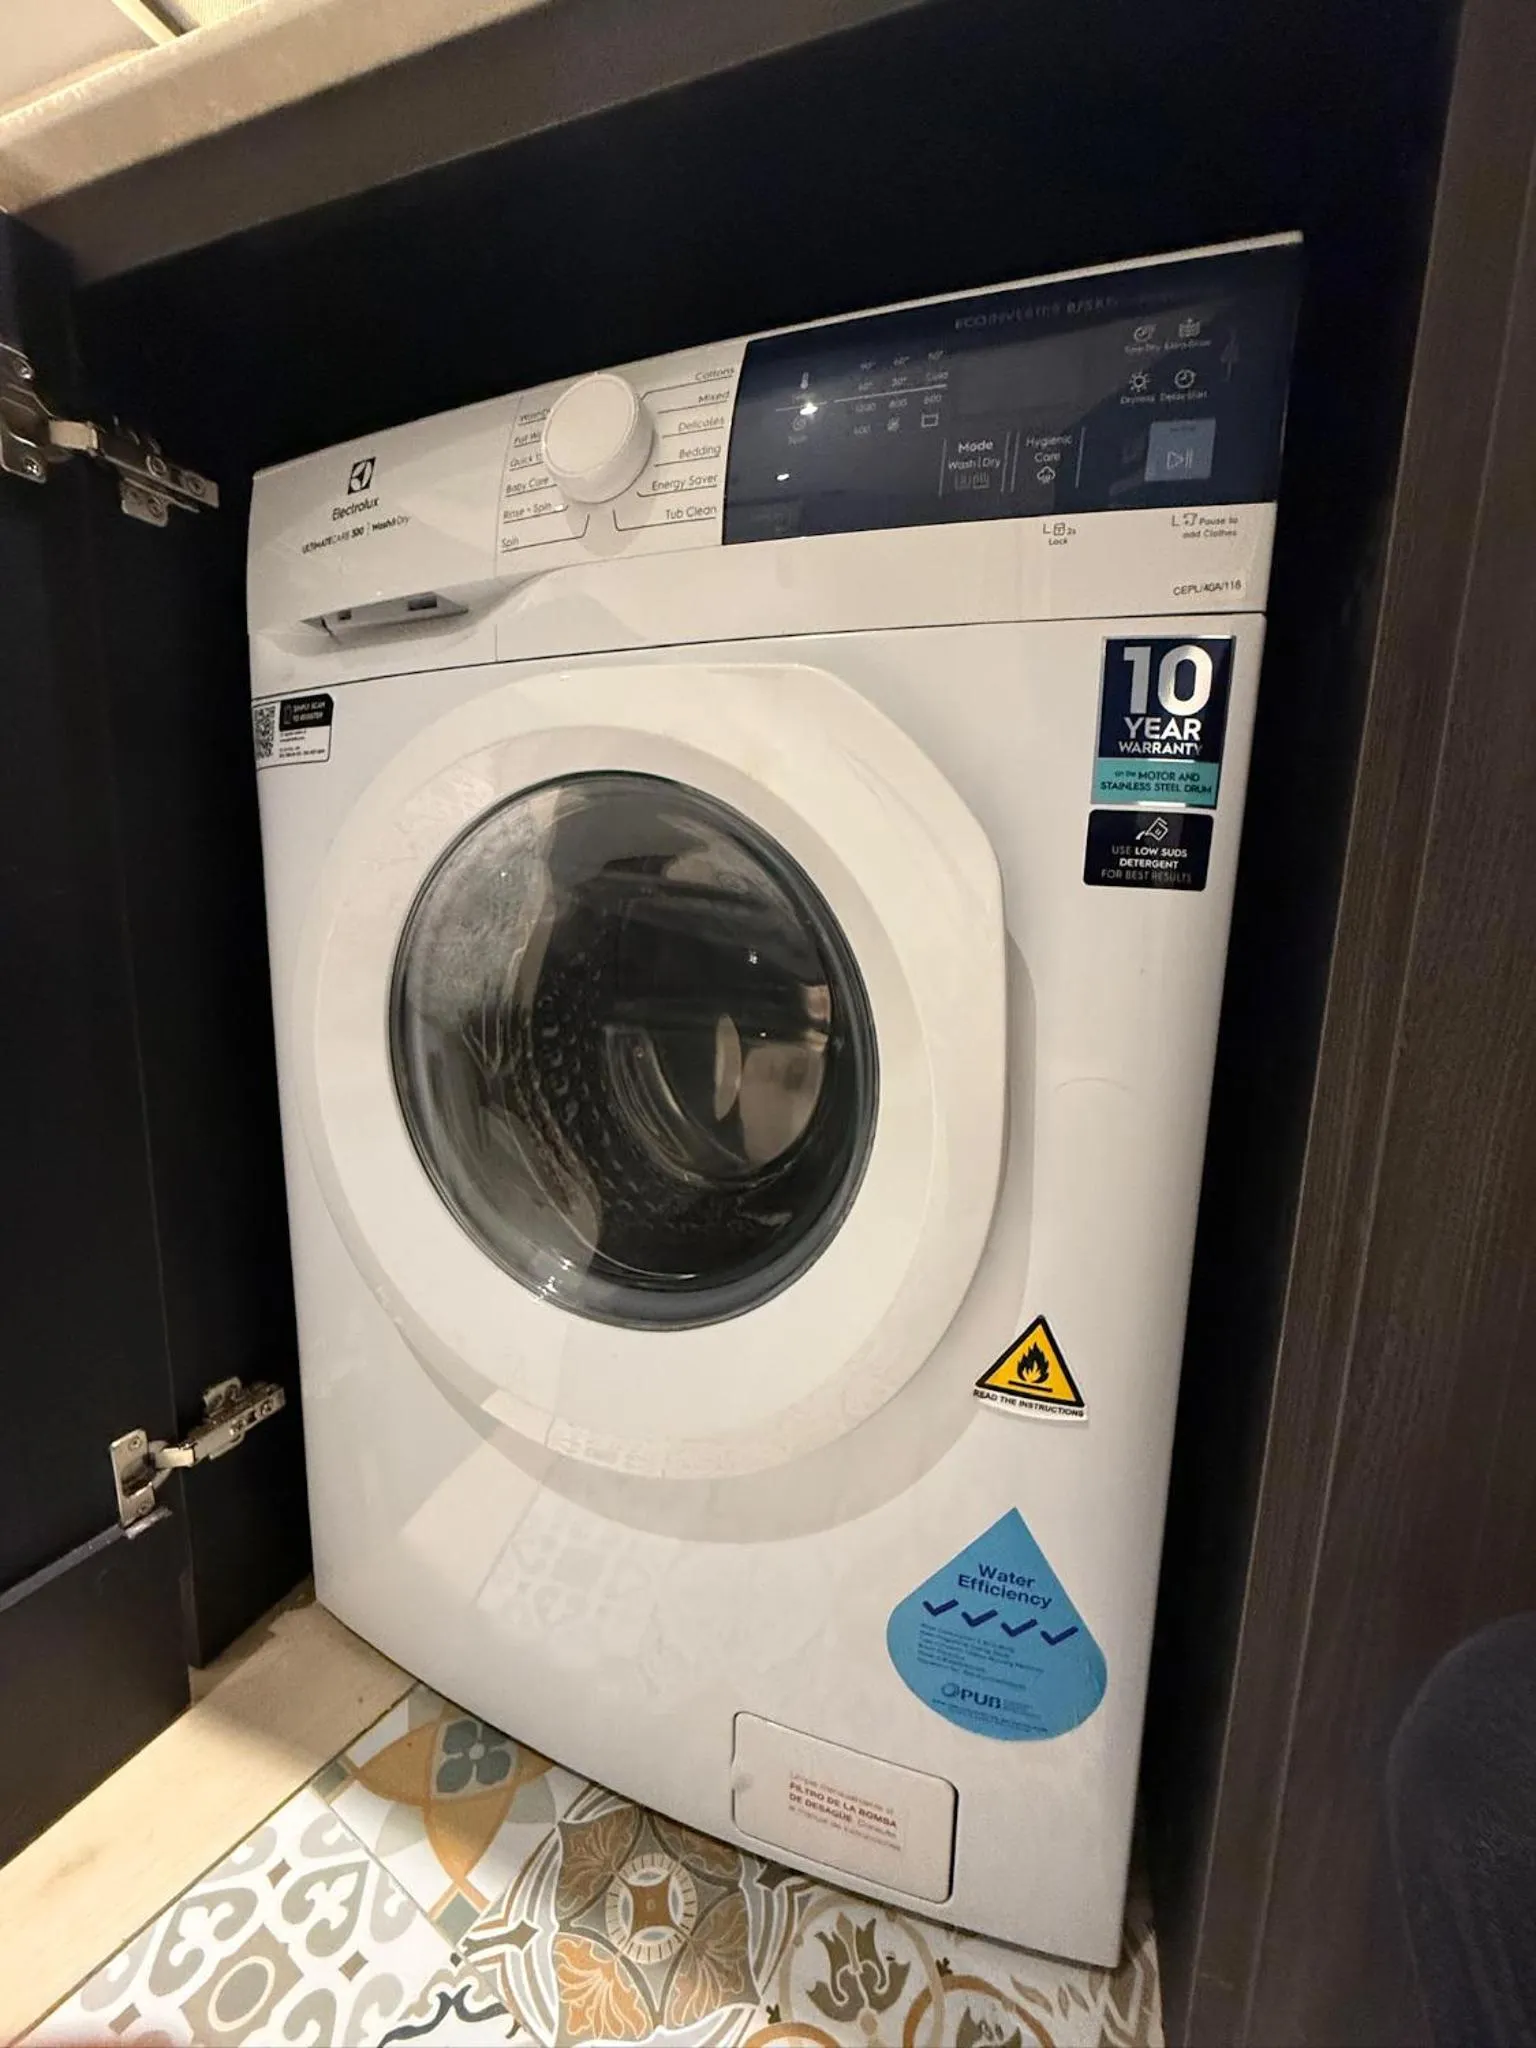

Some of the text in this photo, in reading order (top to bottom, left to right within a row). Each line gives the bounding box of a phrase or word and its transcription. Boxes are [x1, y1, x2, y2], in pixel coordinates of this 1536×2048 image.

[695, 367, 735, 381] Cottons
[698, 390, 731, 403] Mixed
[678, 416, 725, 433] Delicates
[958, 440, 994, 454] Mode
[1026, 434, 1073, 448] Hygienic
[679, 445, 722, 460] Bedding
[1034, 451, 1061, 463] Care
[948, 456, 1001, 471] Wash Dry
[652, 473, 718, 493] Energy Saver
[332, 497, 380, 521] Electrolux
[666, 505, 717, 520] Tub Clean
[1200, 514, 1225, 526] Pause
[1048, 537, 1068, 546] Lock
[1183, 529, 1238, 539] add Clothes
[1123, 644, 1213, 716] 10
[1124, 717, 1202, 741] YEAR
[1118, 741, 1203, 756] WARRANTY
[1138, 771, 1176, 782] MOTOR
[1178, 773, 1200, 783] AND
[1101, 781, 1212, 794] STAINLESS STEEL DRUM
[1111, 845, 1188, 858] USE LOW SUDS
[1119, 857, 1180, 870] DETERGENT
[1101, 868, 1192, 884] FOR BEST RESULTS
[972, 1388, 1085, 1418] READ THE INSTRUCTIONS
[978, 1563, 1036, 1588] Water
[957, 1574, 1053, 1609] Efficiency
[960, 1688, 1002, 1709] PUB
[789, 1792, 802, 1804] DE
[789, 1781, 825, 1800] FILTRO
[827, 1795, 841, 1807] DE
[843, 1801, 857, 1813] LA
[858, 1808, 897, 1828] BOMBA
